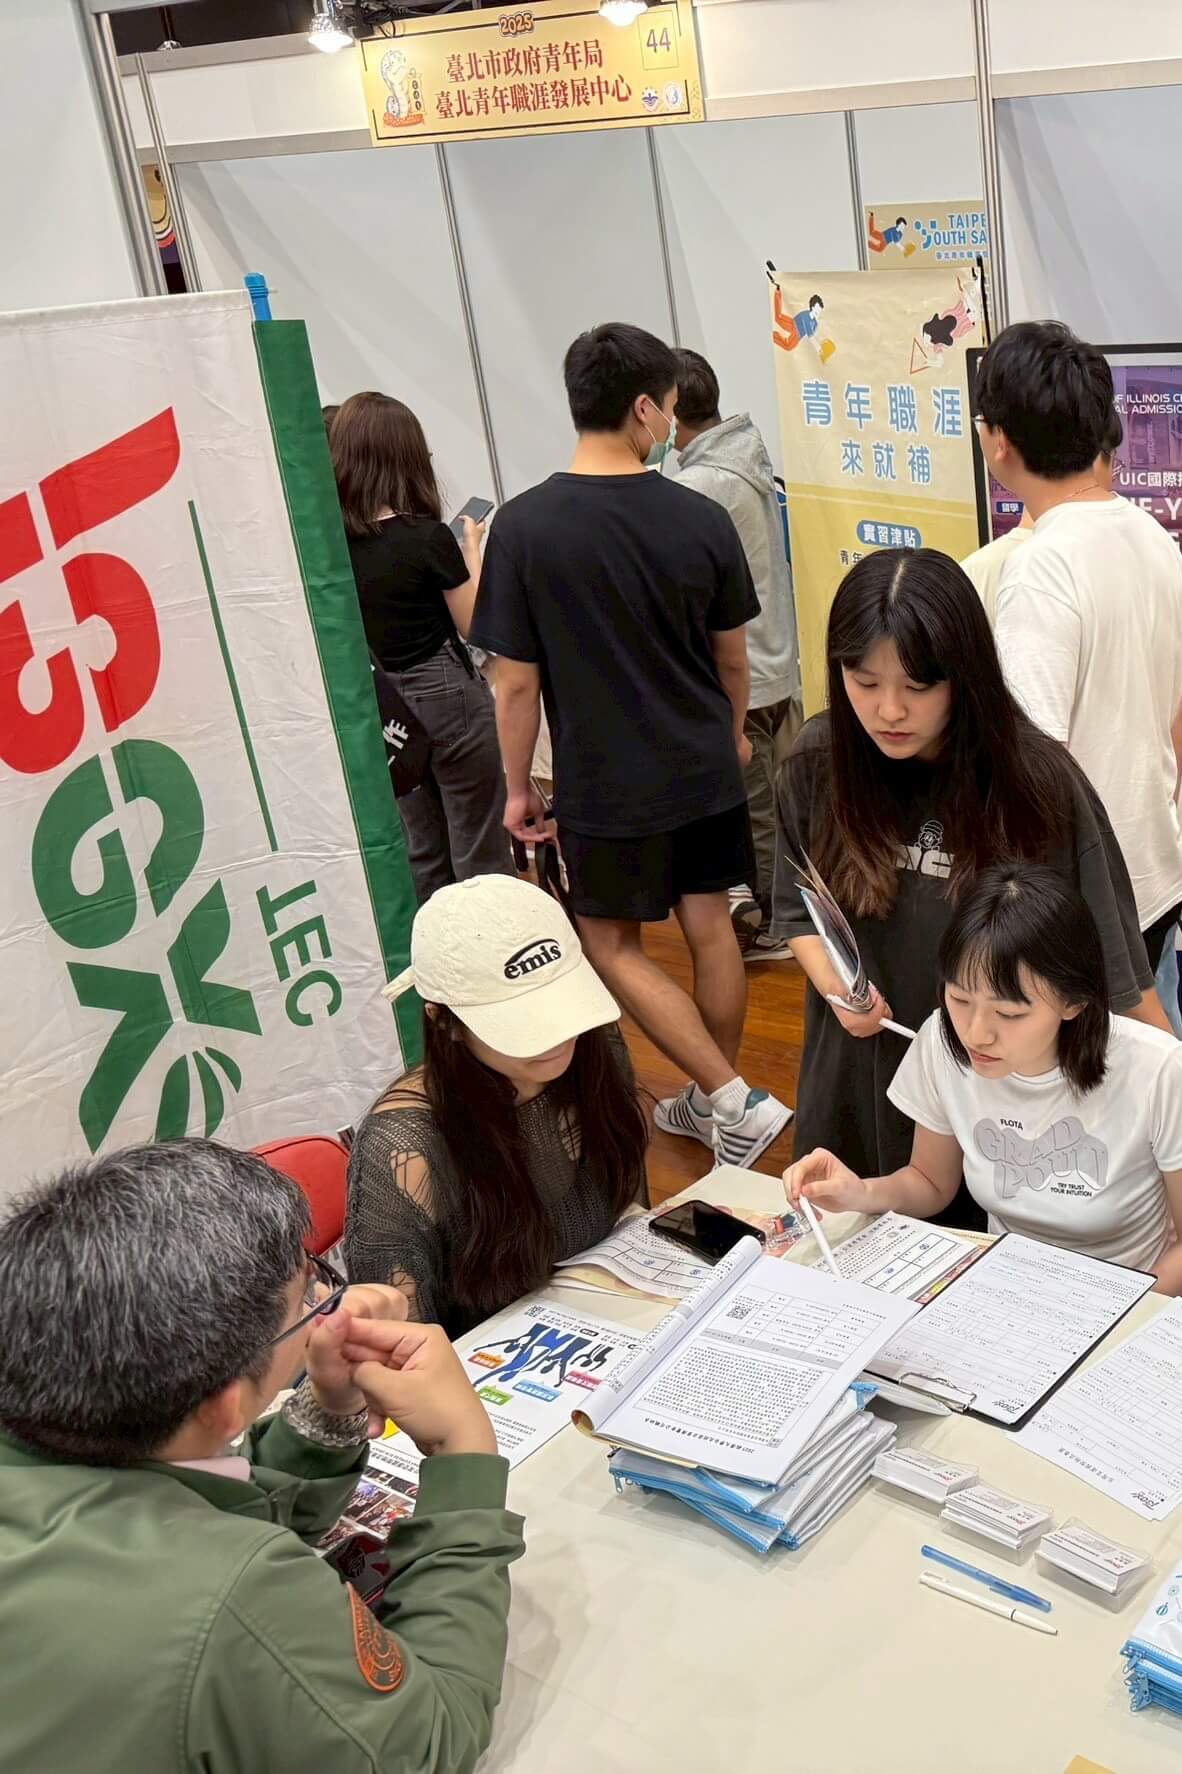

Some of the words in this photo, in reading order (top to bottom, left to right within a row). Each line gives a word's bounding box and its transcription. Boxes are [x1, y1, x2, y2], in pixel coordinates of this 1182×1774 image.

[500, 12, 534, 35] 2025
[646, 27, 671, 54] 44
[446, 39, 603, 83] 臺北市政府青年局
[436, 73, 632, 119] 臺北青年職涯發展中心
[801, 380, 964, 437] 青年職涯
[1127, 394, 1169, 403] ILLINOIS
[841, 440, 931, 484] 來就補
[863, 523, 916, 548] 實習津貼
[504, 945, 561, 979] emis
[1000, 1118, 1023, 1130] FLOTA
